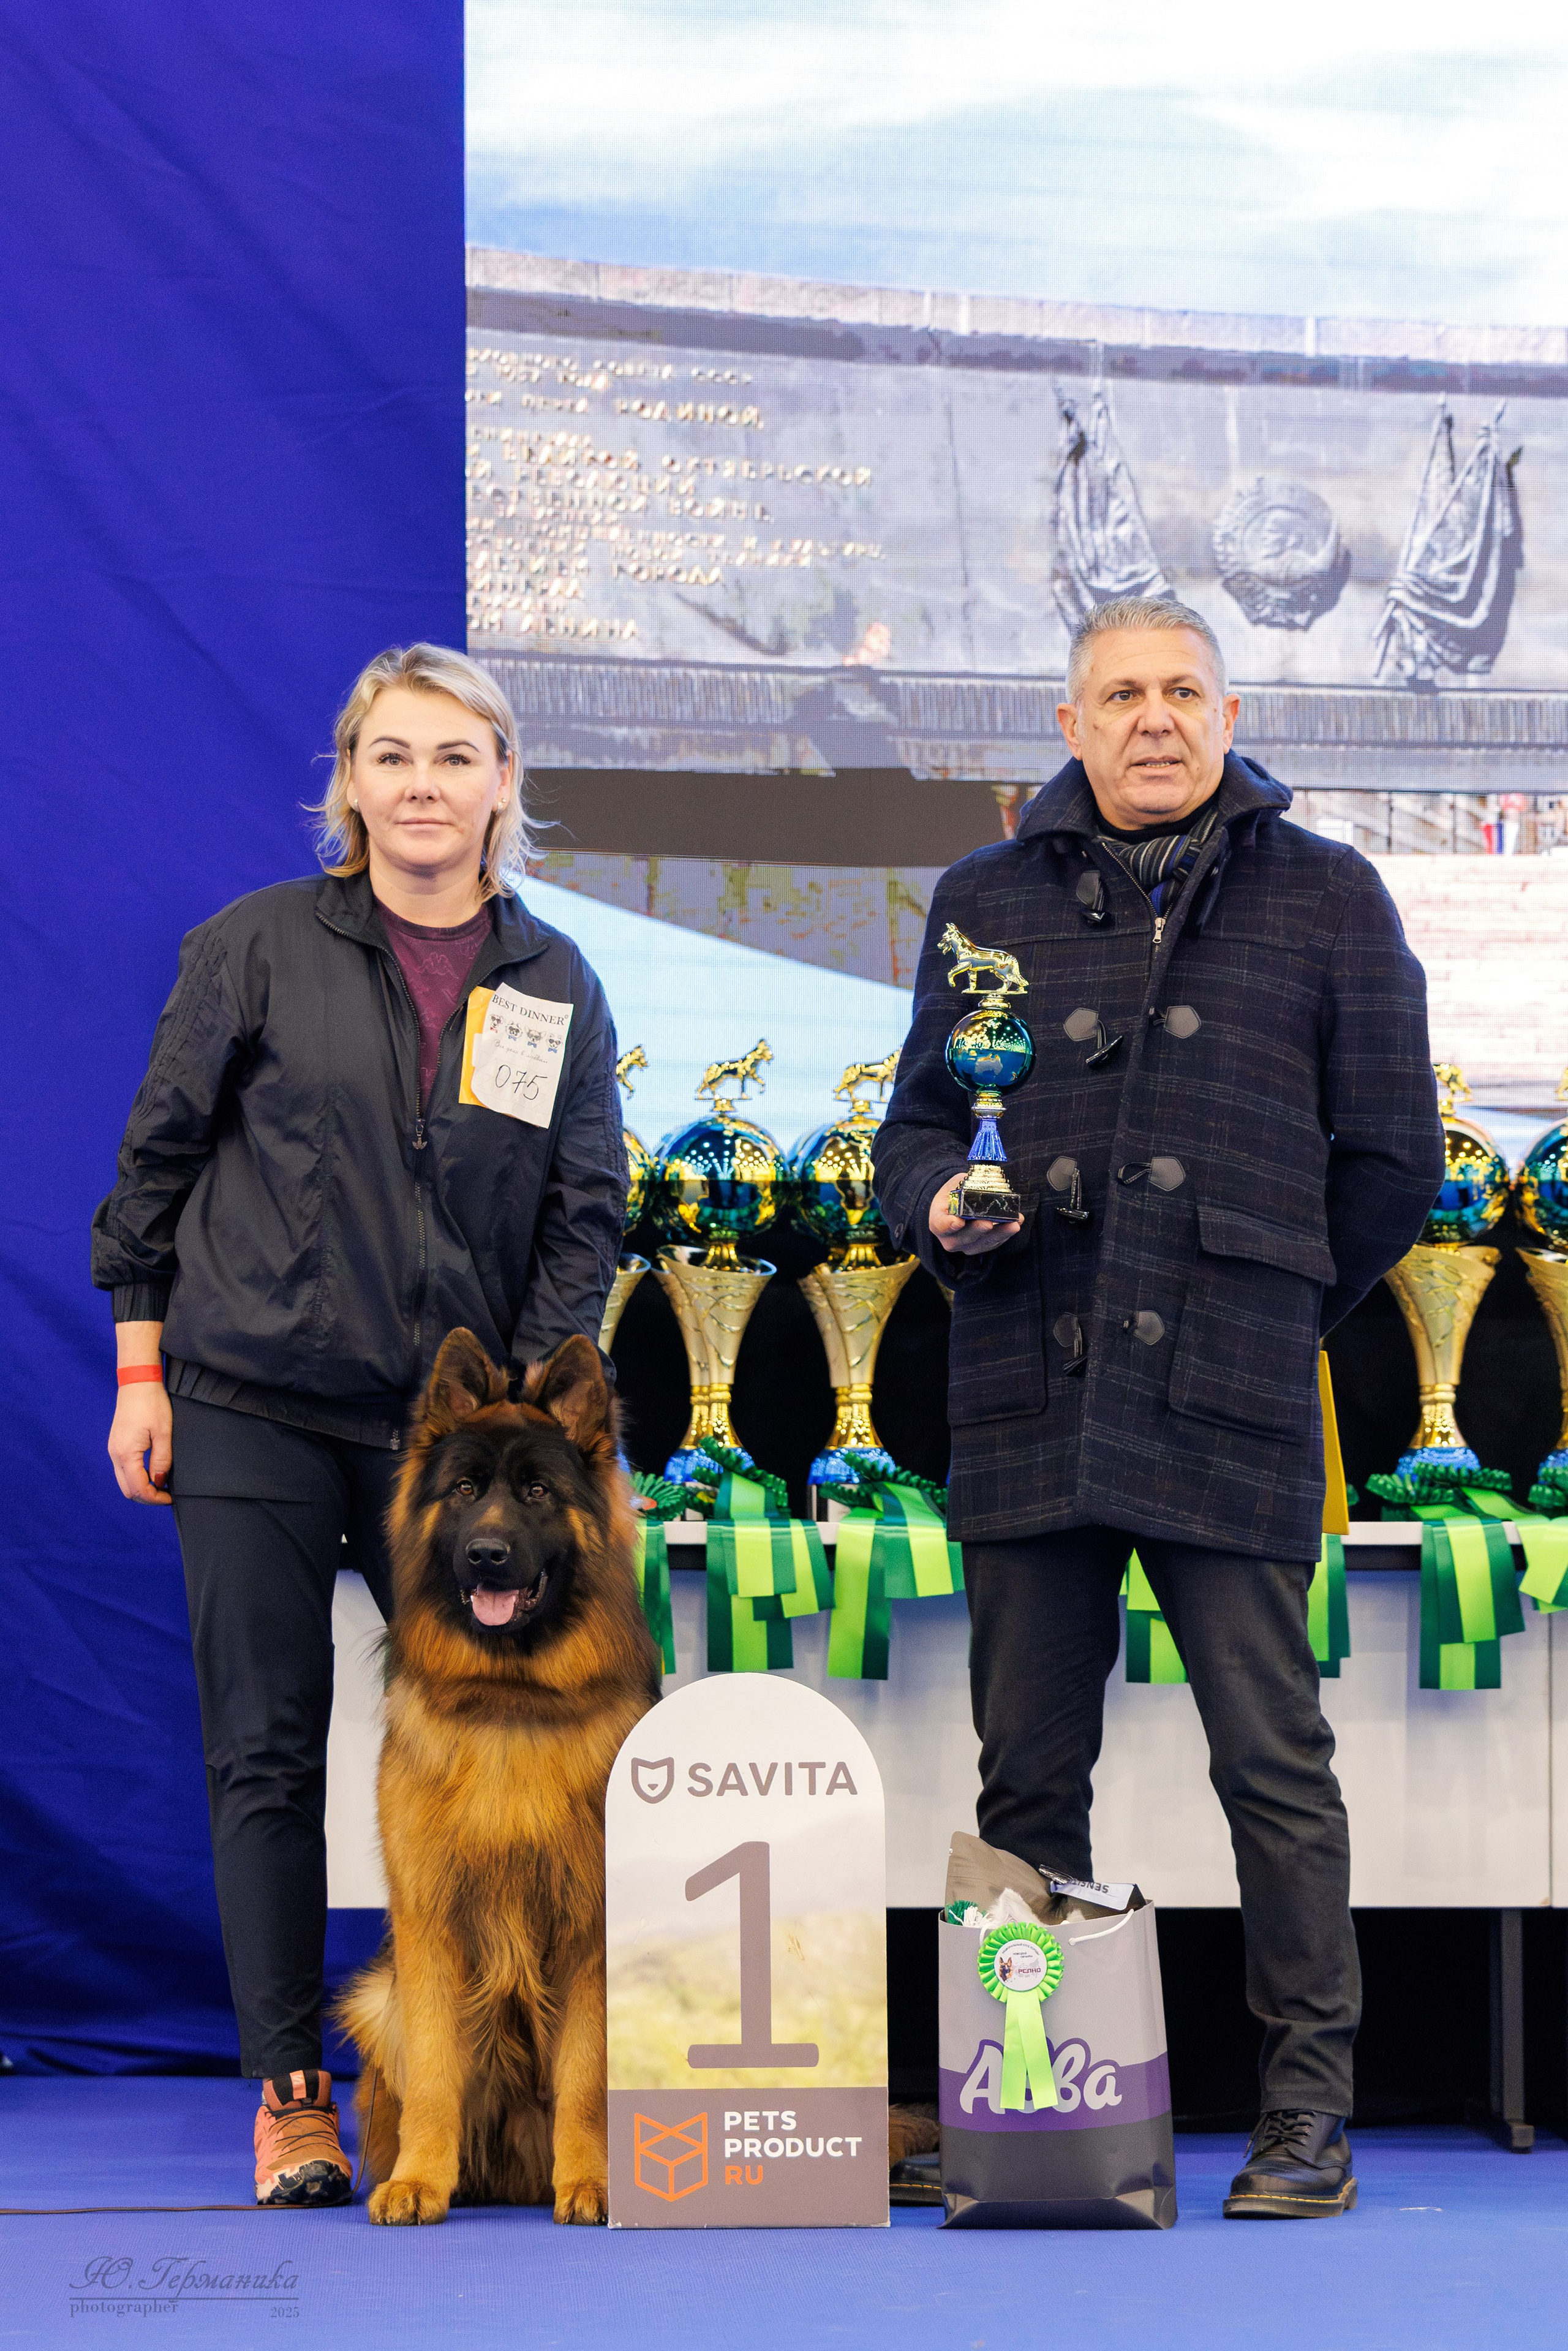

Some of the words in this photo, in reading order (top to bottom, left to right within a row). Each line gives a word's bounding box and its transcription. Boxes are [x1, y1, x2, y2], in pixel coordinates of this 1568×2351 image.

[502, 443, 639, 471] ВЕЛИКОЙ
[662, 455, 872, 485] ОКТЯБРЬСКОЙ
[492, 994, 517, 1012] BEST
[519, 1007, 565, 1025] DINNER
[495, 1065, 548, 1100] 075
[687, 1761, 858, 1797] SAVITA
[685, 1841, 819, 2069] 1
[960, 2043, 1122, 2114] Ава
[724, 2110, 796, 2130] PETS
[724, 2137, 862, 2158] PRODUCT
[725, 2165, 763, 2185] RU
